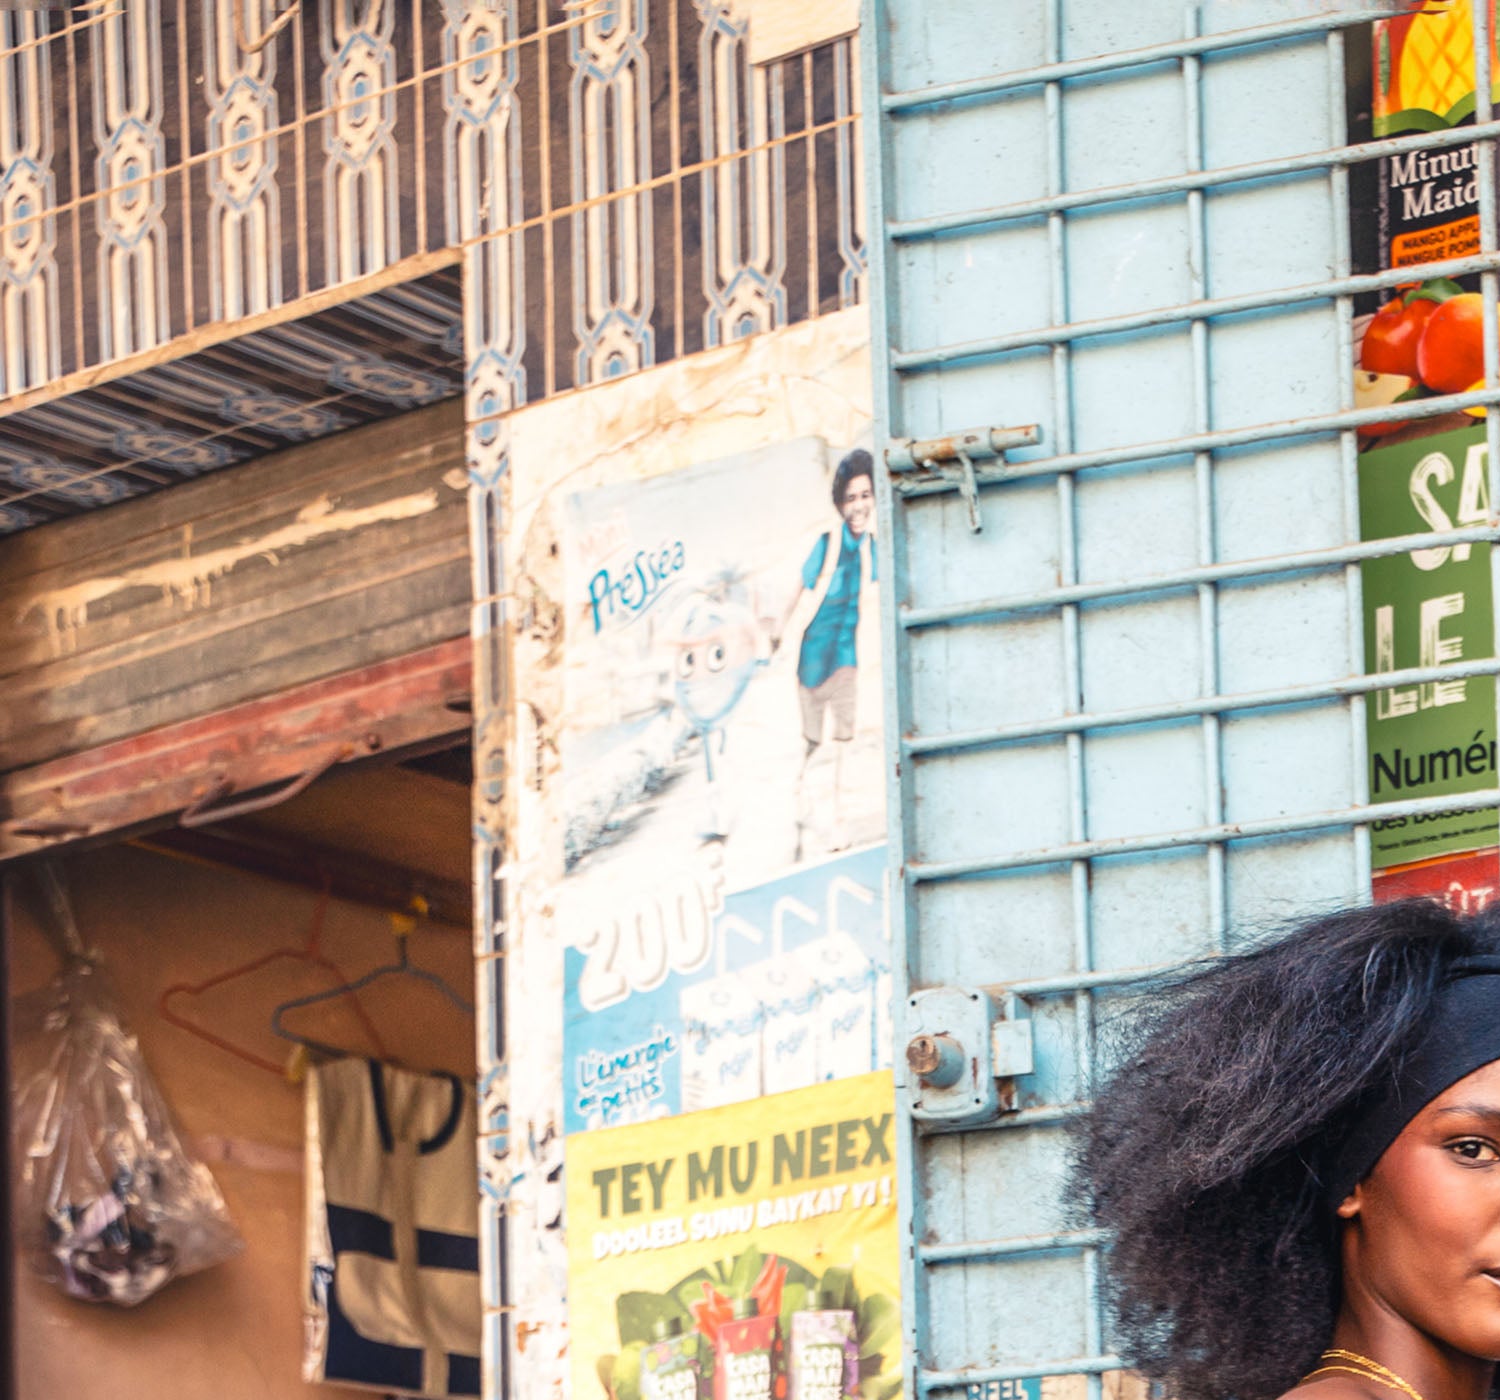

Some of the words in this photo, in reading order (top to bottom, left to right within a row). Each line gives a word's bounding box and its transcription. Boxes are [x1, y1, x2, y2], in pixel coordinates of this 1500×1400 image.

[1390, 142, 1480, 188] Minut
[1375, 591, 1467, 720] LE
[592, 1158, 675, 1219] TEY
[687, 1140, 758, 1203] MU
[772, 1112, 894, 1186] NEEX
[592, 1216, 688, 1260] DOOLEEL
[689, 1202, 753, 1241] SUNU
